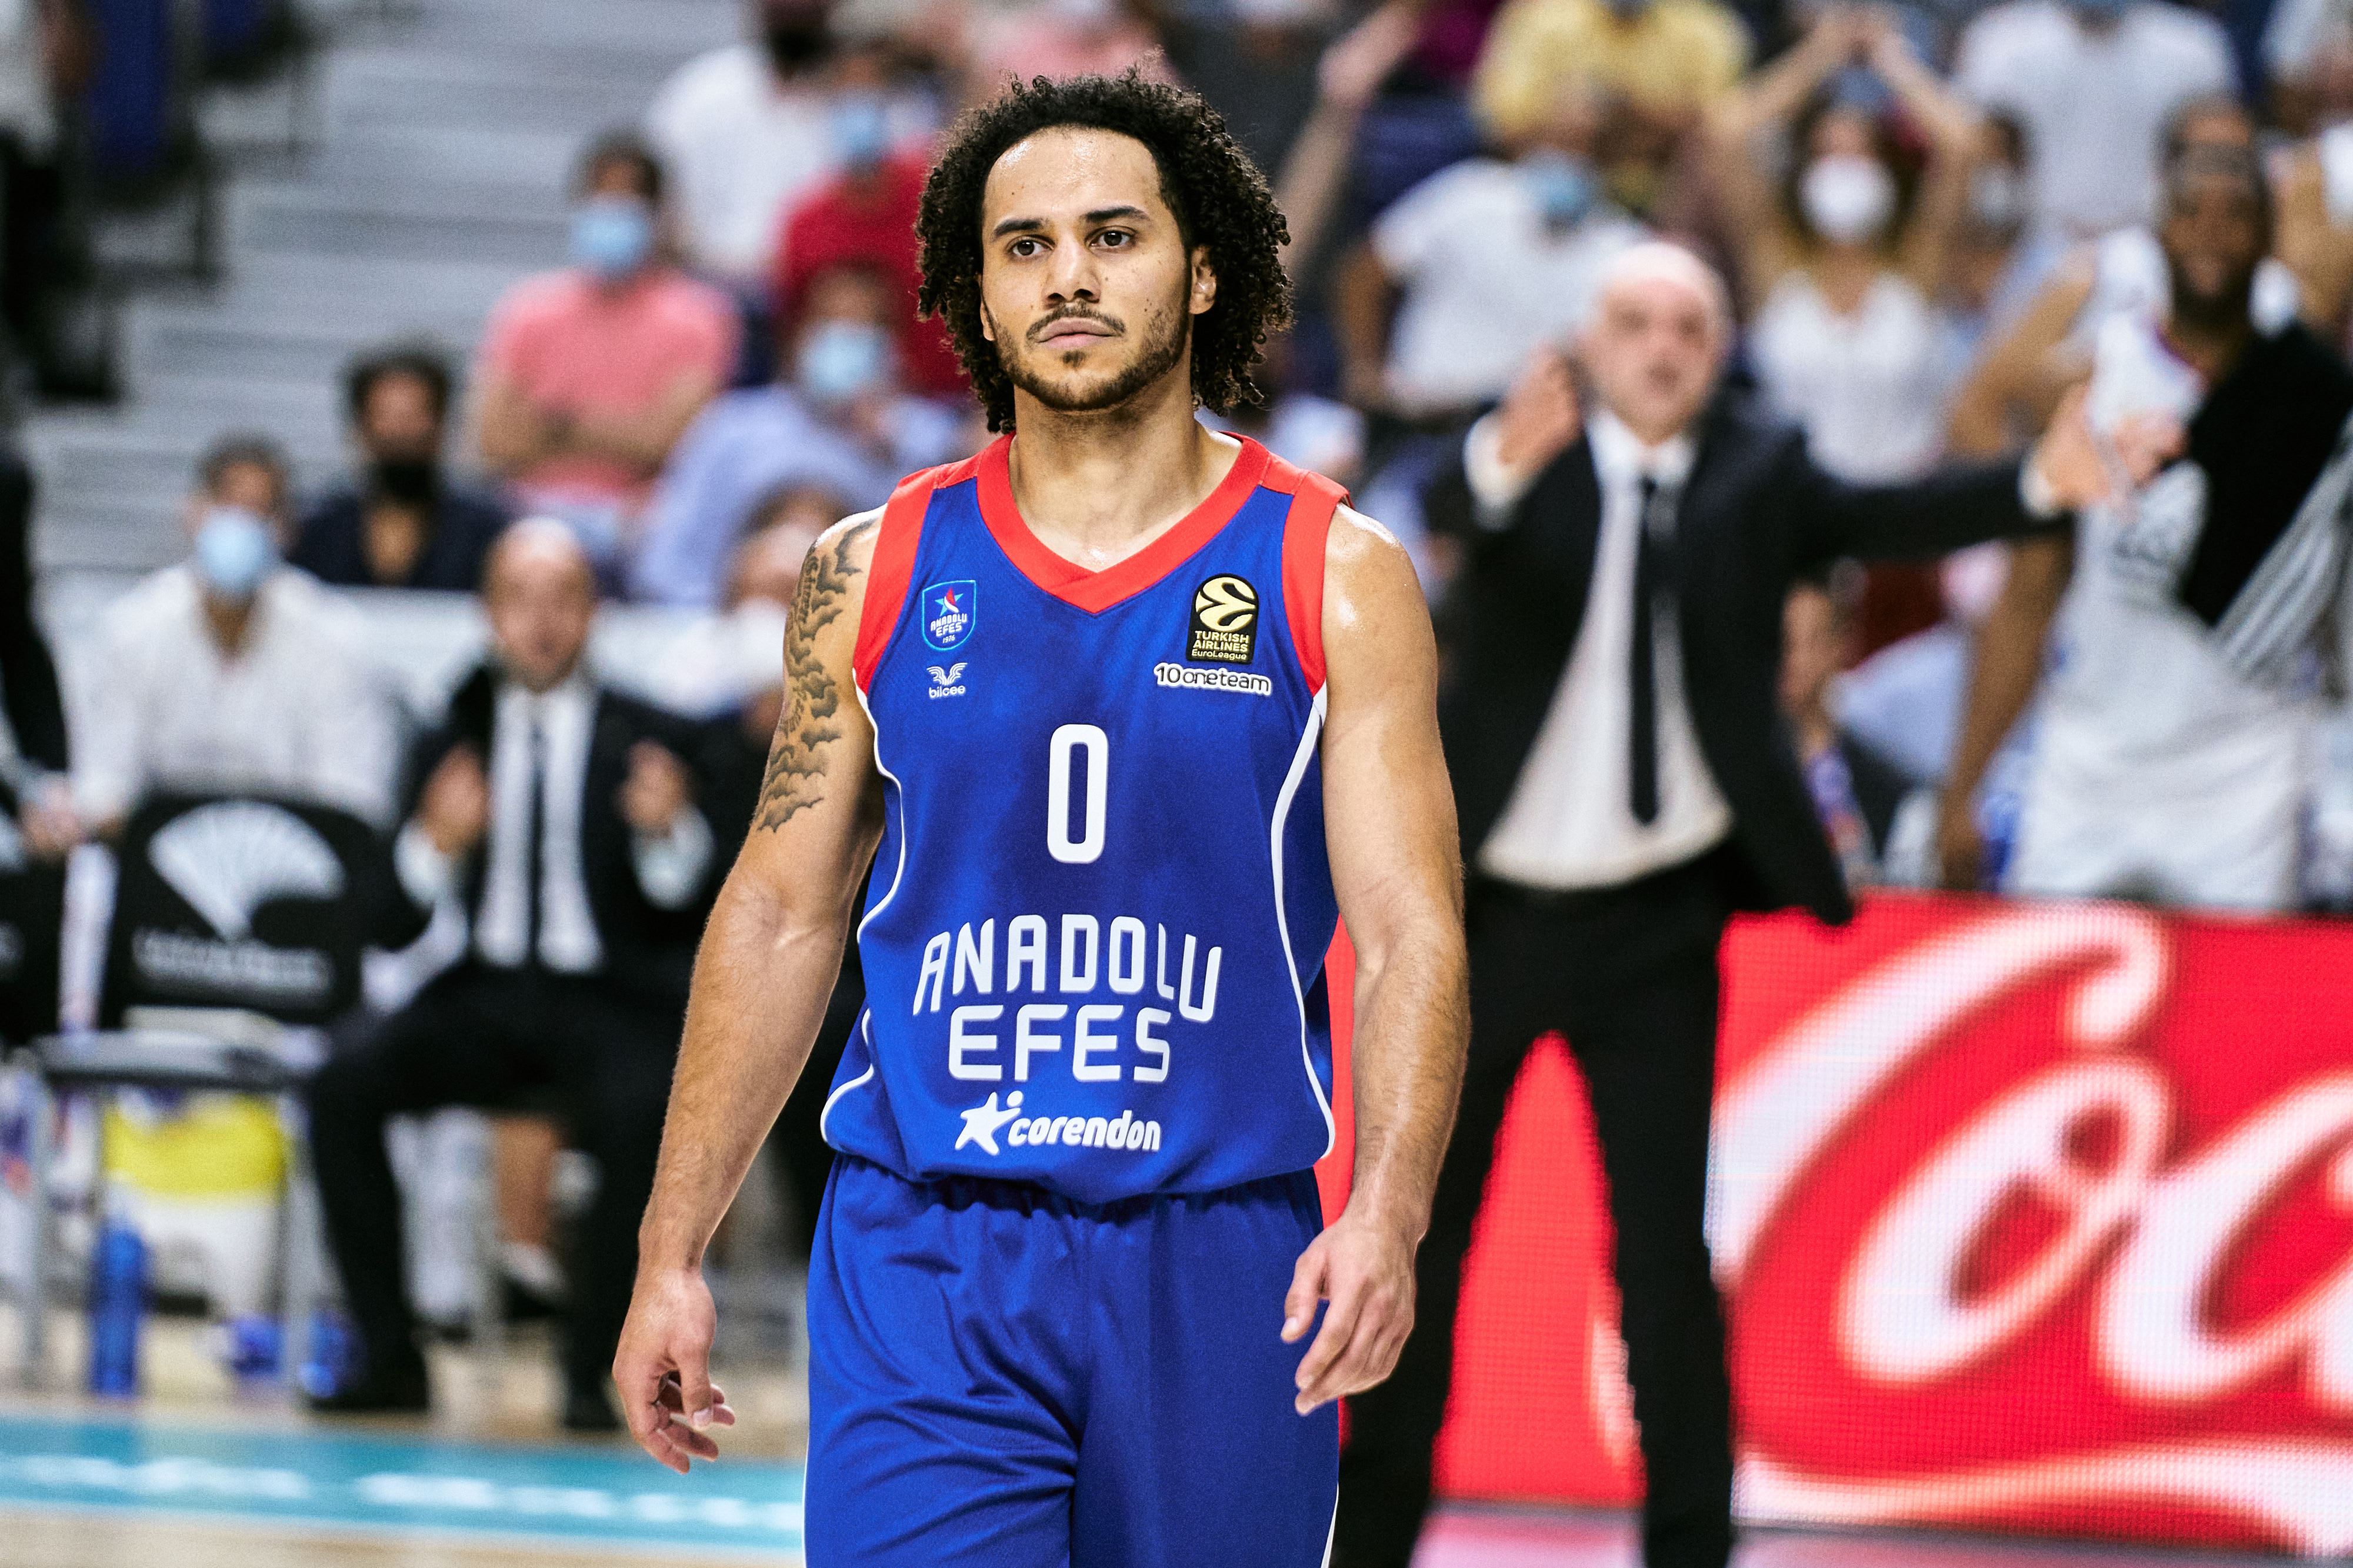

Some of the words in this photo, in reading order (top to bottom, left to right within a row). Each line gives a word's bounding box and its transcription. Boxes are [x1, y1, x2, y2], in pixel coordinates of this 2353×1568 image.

[931, 613, 968, 632] ANADOLU
[936, 622, 962, 638] EFES
[942, 635, 955, 643] 1976
[1195, 630, 1250, 644] TURKISH
[1193, 639, 1248, 653] AIRLINES
[1191, 649, 1248, 660] EuroLeague
[929, 685, 966, 699] bilcee
[1046, 723, 1109, 864] 0
[913, 913, 1222, 1022] ANADOLU
[948, 1003, 1172, 1082] EFES
[1007, 1110, 1161, 1152] corendon
